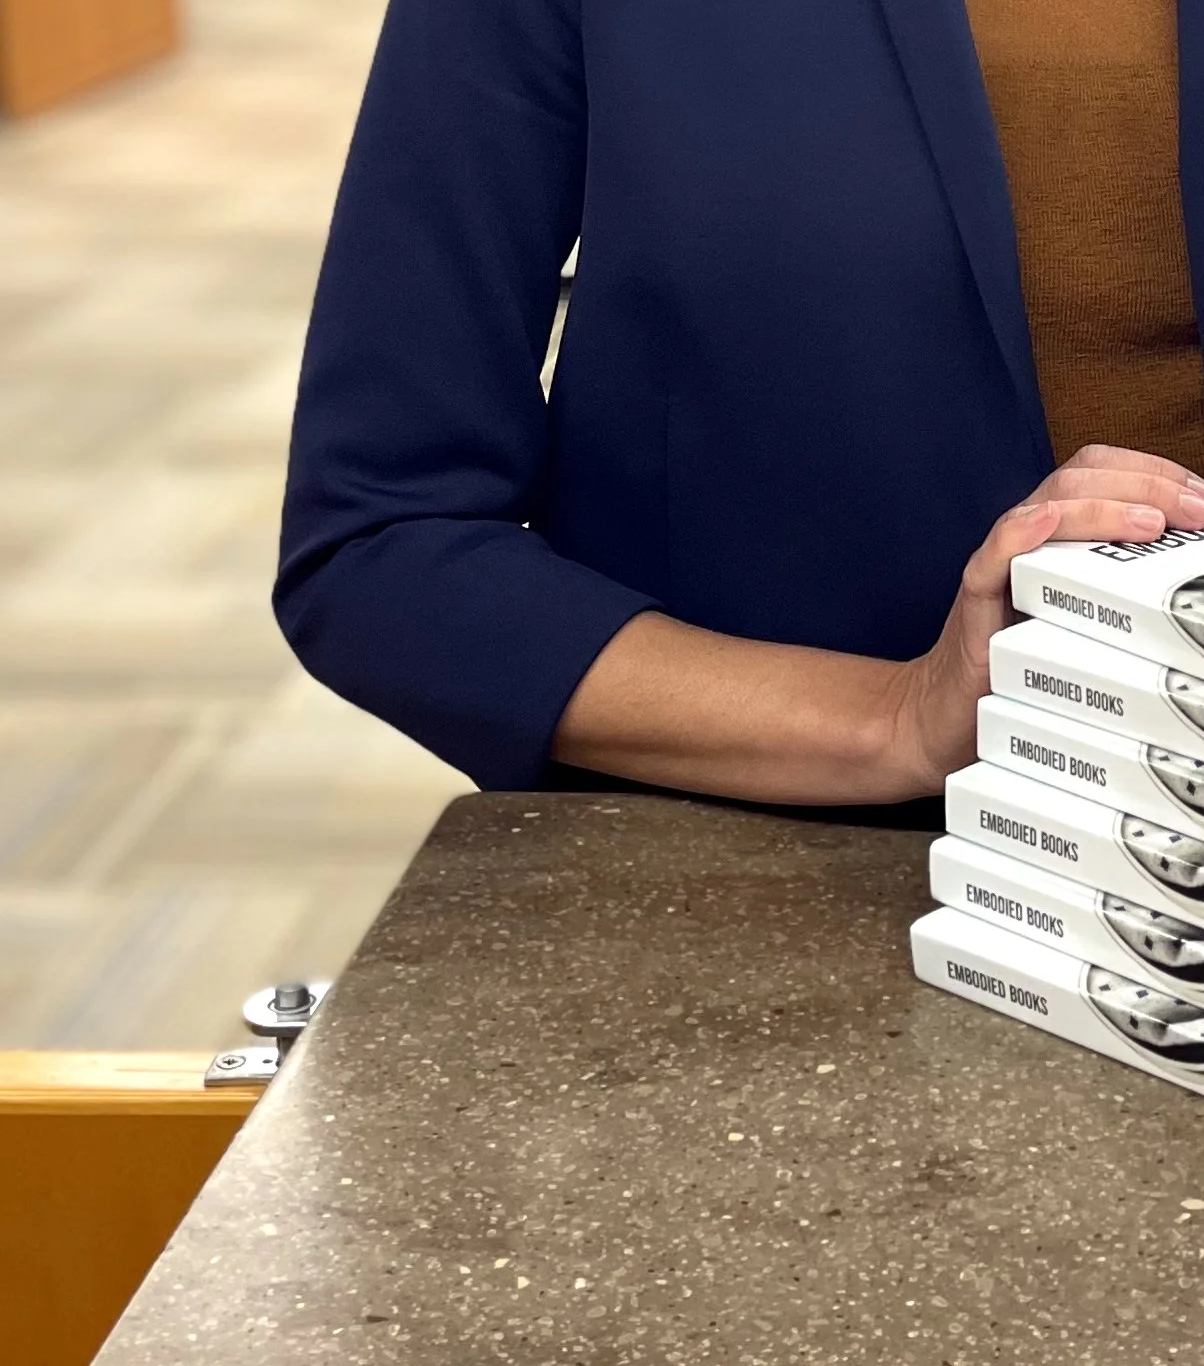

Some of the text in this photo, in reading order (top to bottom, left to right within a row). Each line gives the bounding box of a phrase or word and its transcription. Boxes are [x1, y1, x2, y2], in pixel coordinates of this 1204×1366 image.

[1043, 586, 1131, 633] EMBODIED BOOKS
[1025, 669, 1123, 716] EMBODIED BOOKS
[1011, 736, 1106, 786] EMBODIED BOOKS
[980, 810, 1078, 862] EMBODIED BOOKS
[967, 883, 1063, 937] EMBODIED BOOKS
[947, 961, 1048, 1015] EMBODIED BOOKS
